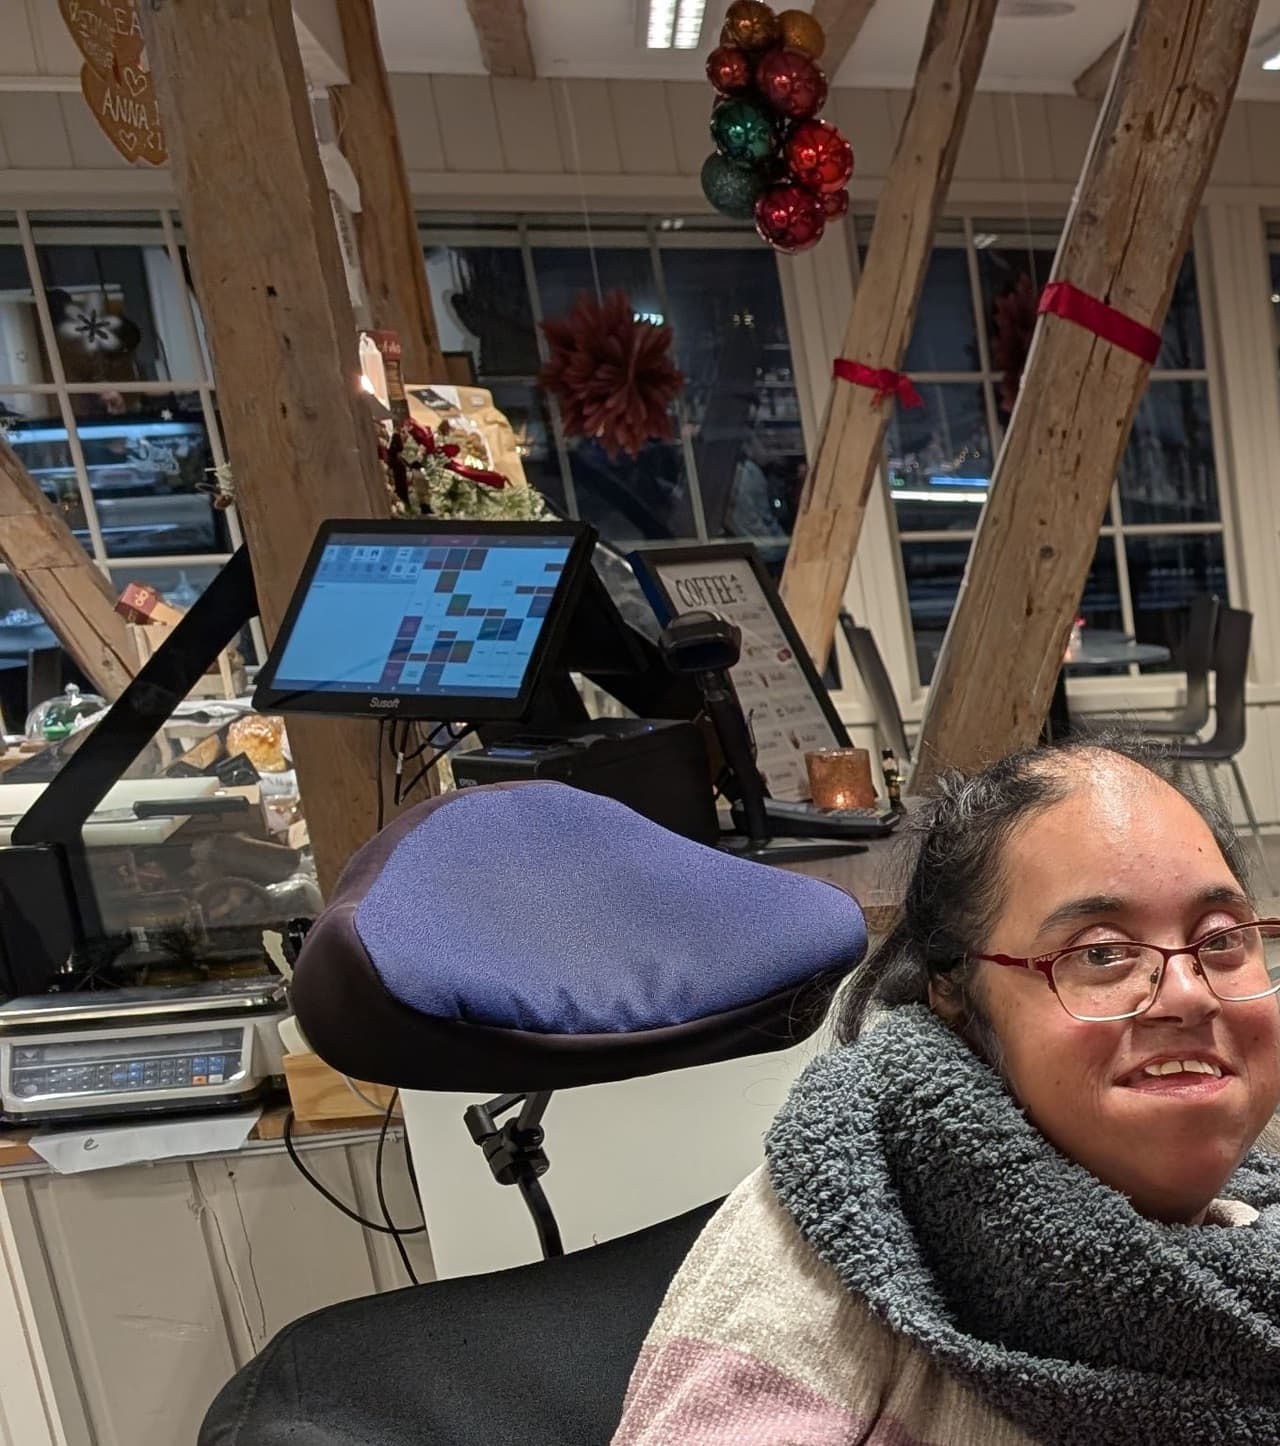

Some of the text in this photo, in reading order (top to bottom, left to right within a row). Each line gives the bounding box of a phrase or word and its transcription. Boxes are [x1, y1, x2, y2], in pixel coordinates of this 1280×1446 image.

[102, 87, 150, 131] ANNA
[675, 575, 737, 607] COFFEE
[369, 696, 400, 709] Susoft
